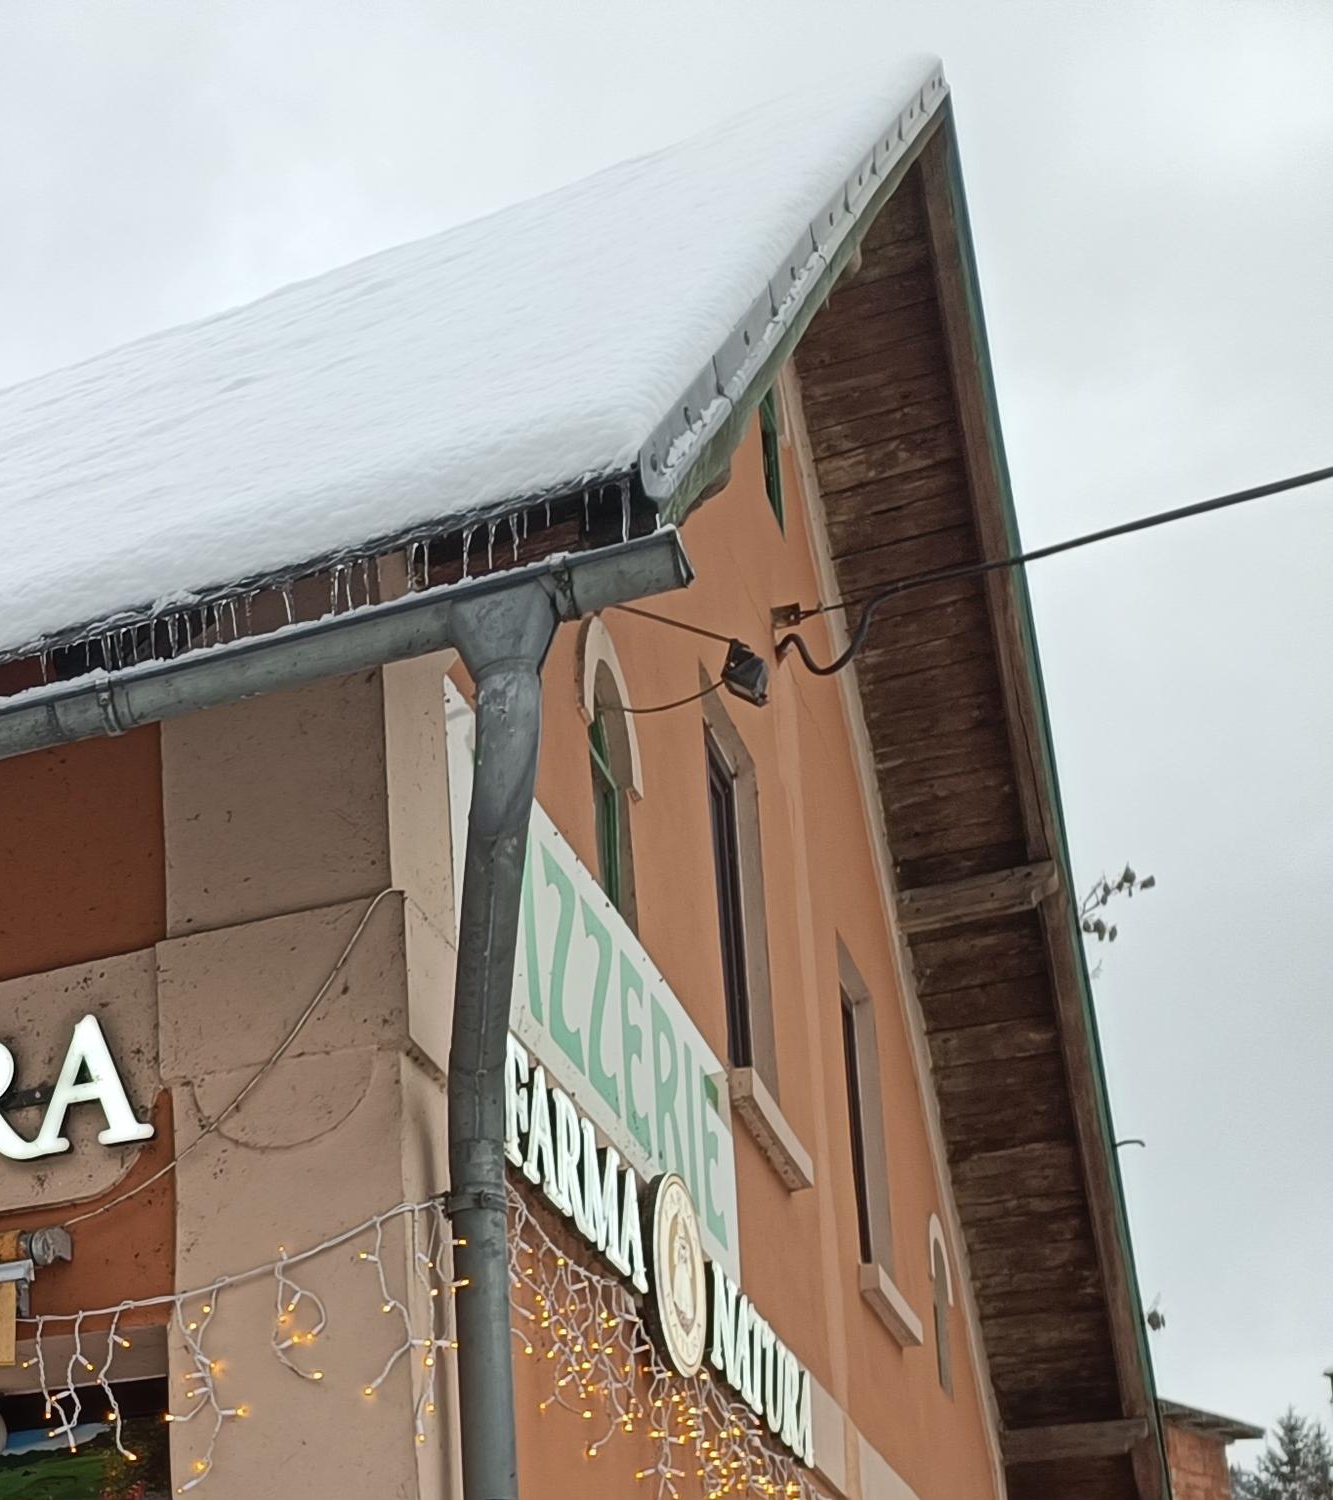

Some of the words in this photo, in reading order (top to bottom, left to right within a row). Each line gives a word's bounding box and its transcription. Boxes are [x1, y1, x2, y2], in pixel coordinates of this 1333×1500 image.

[505, 1030, 649, 1293] FARMA
[521, 830, 728, 1251] IZZERIE
[712, 1259, 815, 1468] NATURA
